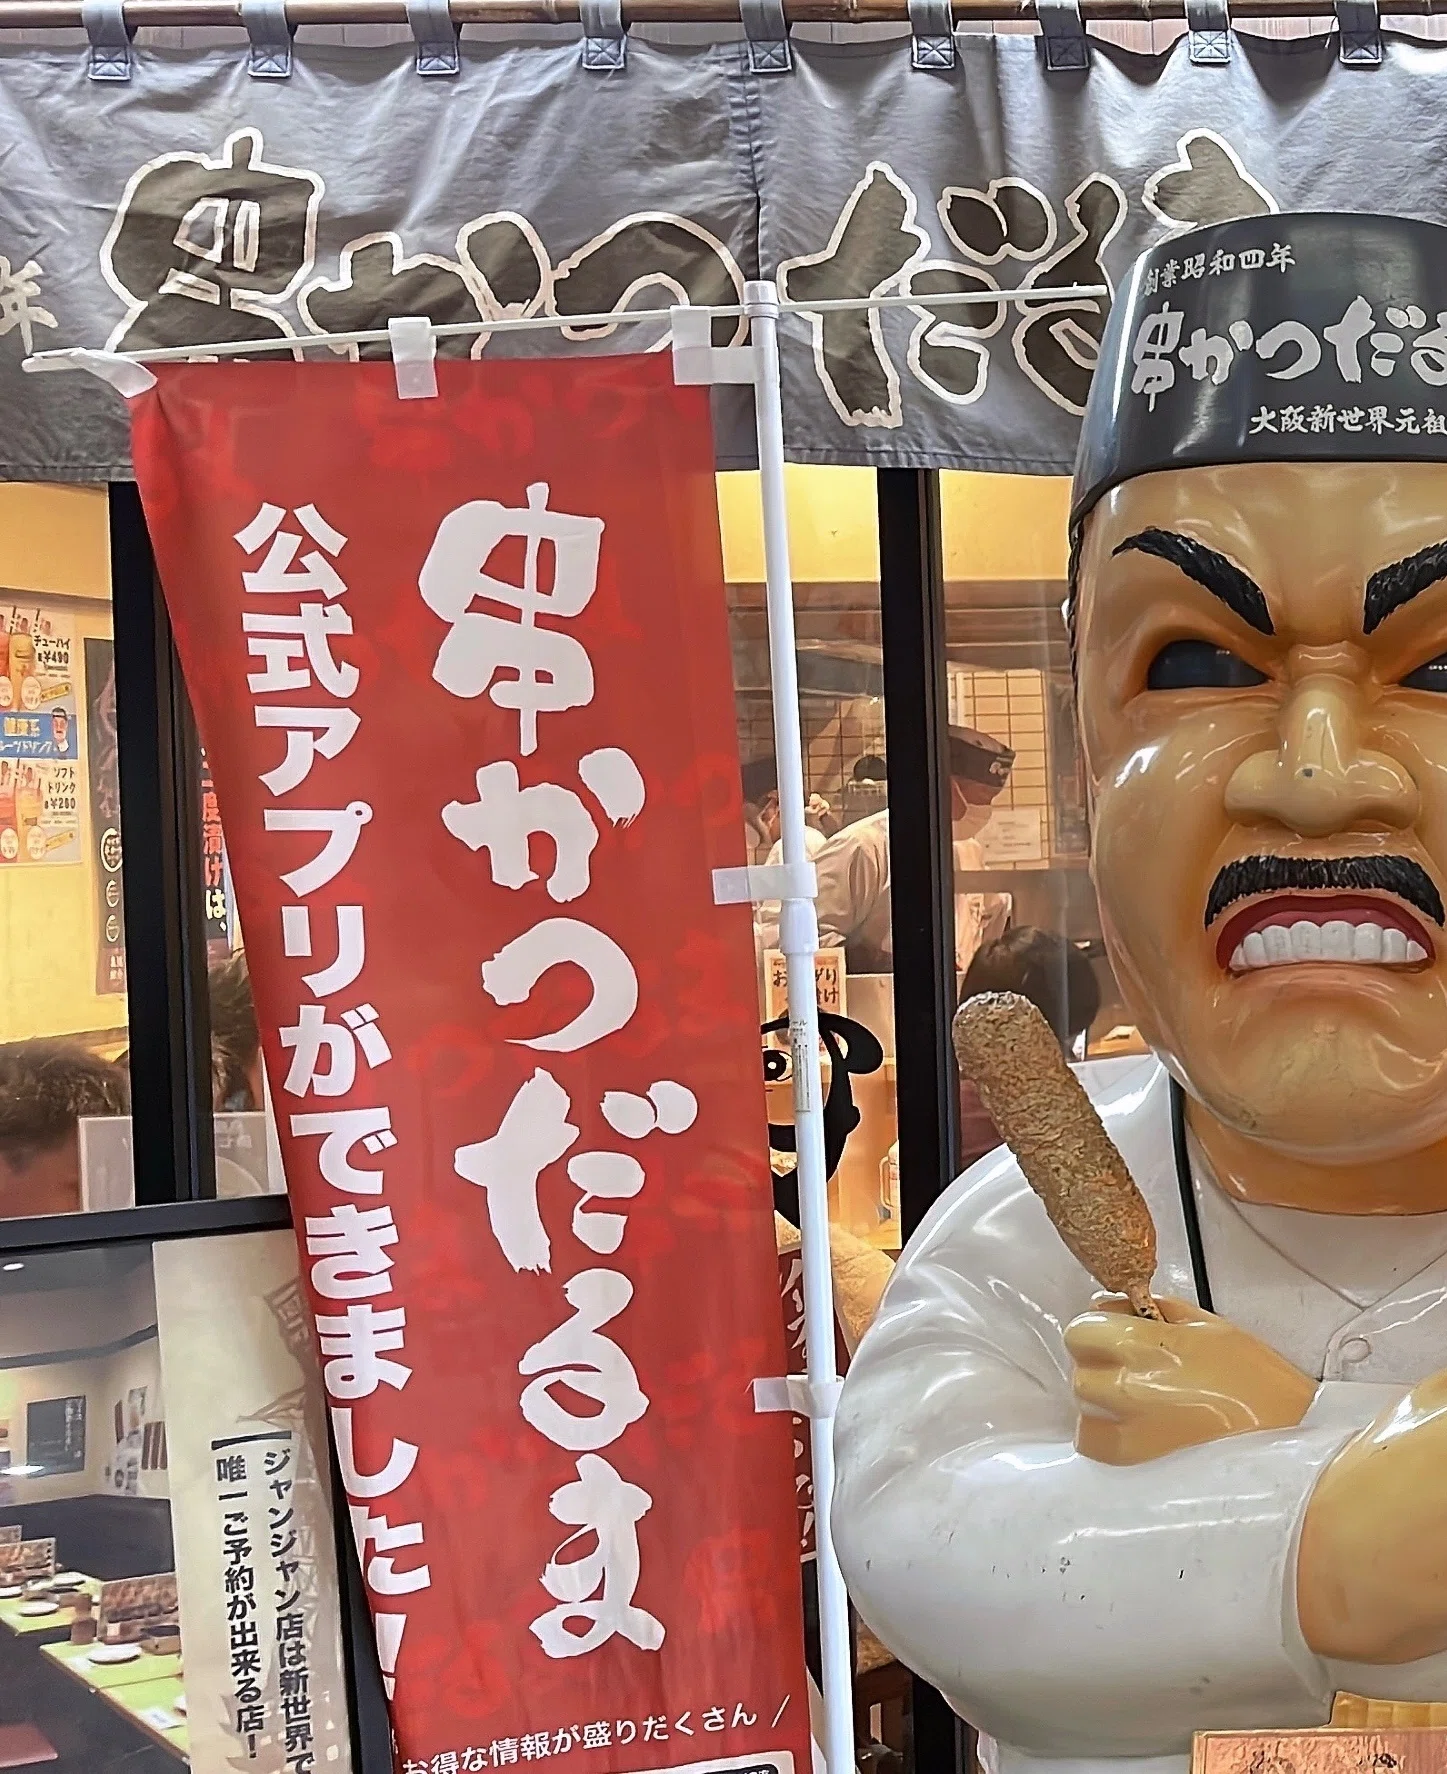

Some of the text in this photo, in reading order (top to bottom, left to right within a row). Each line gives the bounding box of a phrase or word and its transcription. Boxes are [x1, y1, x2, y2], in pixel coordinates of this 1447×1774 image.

[99, 126, 1281, 429] 串かつだる
[1142, 241, 1297, 297] 創業昭和四年
[417, 481, 699, 1659] 串かつだるま
[215, 1454, 266, 1761] 唯一ご予約が出来る店!
